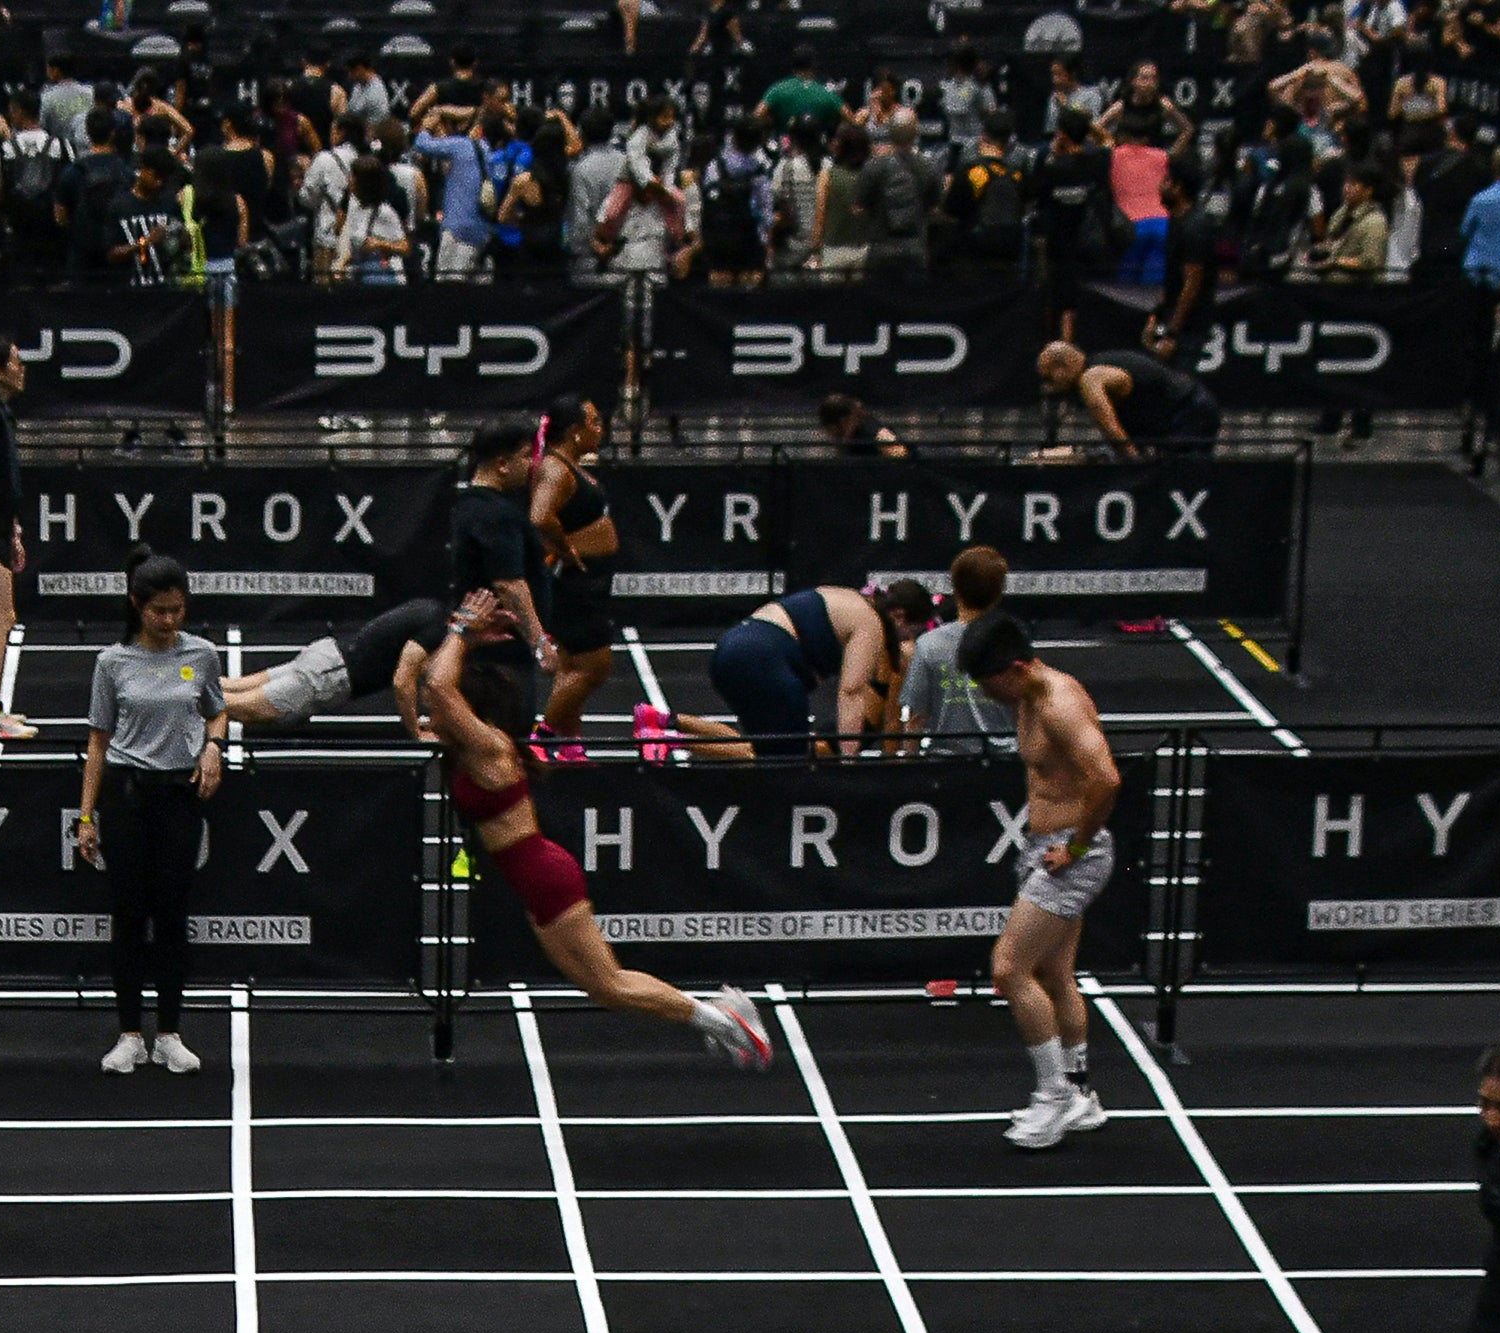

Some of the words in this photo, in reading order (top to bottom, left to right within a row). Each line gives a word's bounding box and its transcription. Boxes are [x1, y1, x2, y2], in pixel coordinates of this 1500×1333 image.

[315, 326, 549, 376] BYD
[732, 324, 967, 374] BYD
[40, 493, 374, 544] HYROX
[870, 490, 1207, 541] HYROX
[584, 803, 1028, 871] HYROX
[54, 916, 84, 936] OF
[208, 918, 305, 939] RACING
[602, 920, 675, 939] ORLD
[685, 918, 772, 938] SERIES
[782, 918, 811, 936] OF
[822, 915, 925, 934] FITNESS
